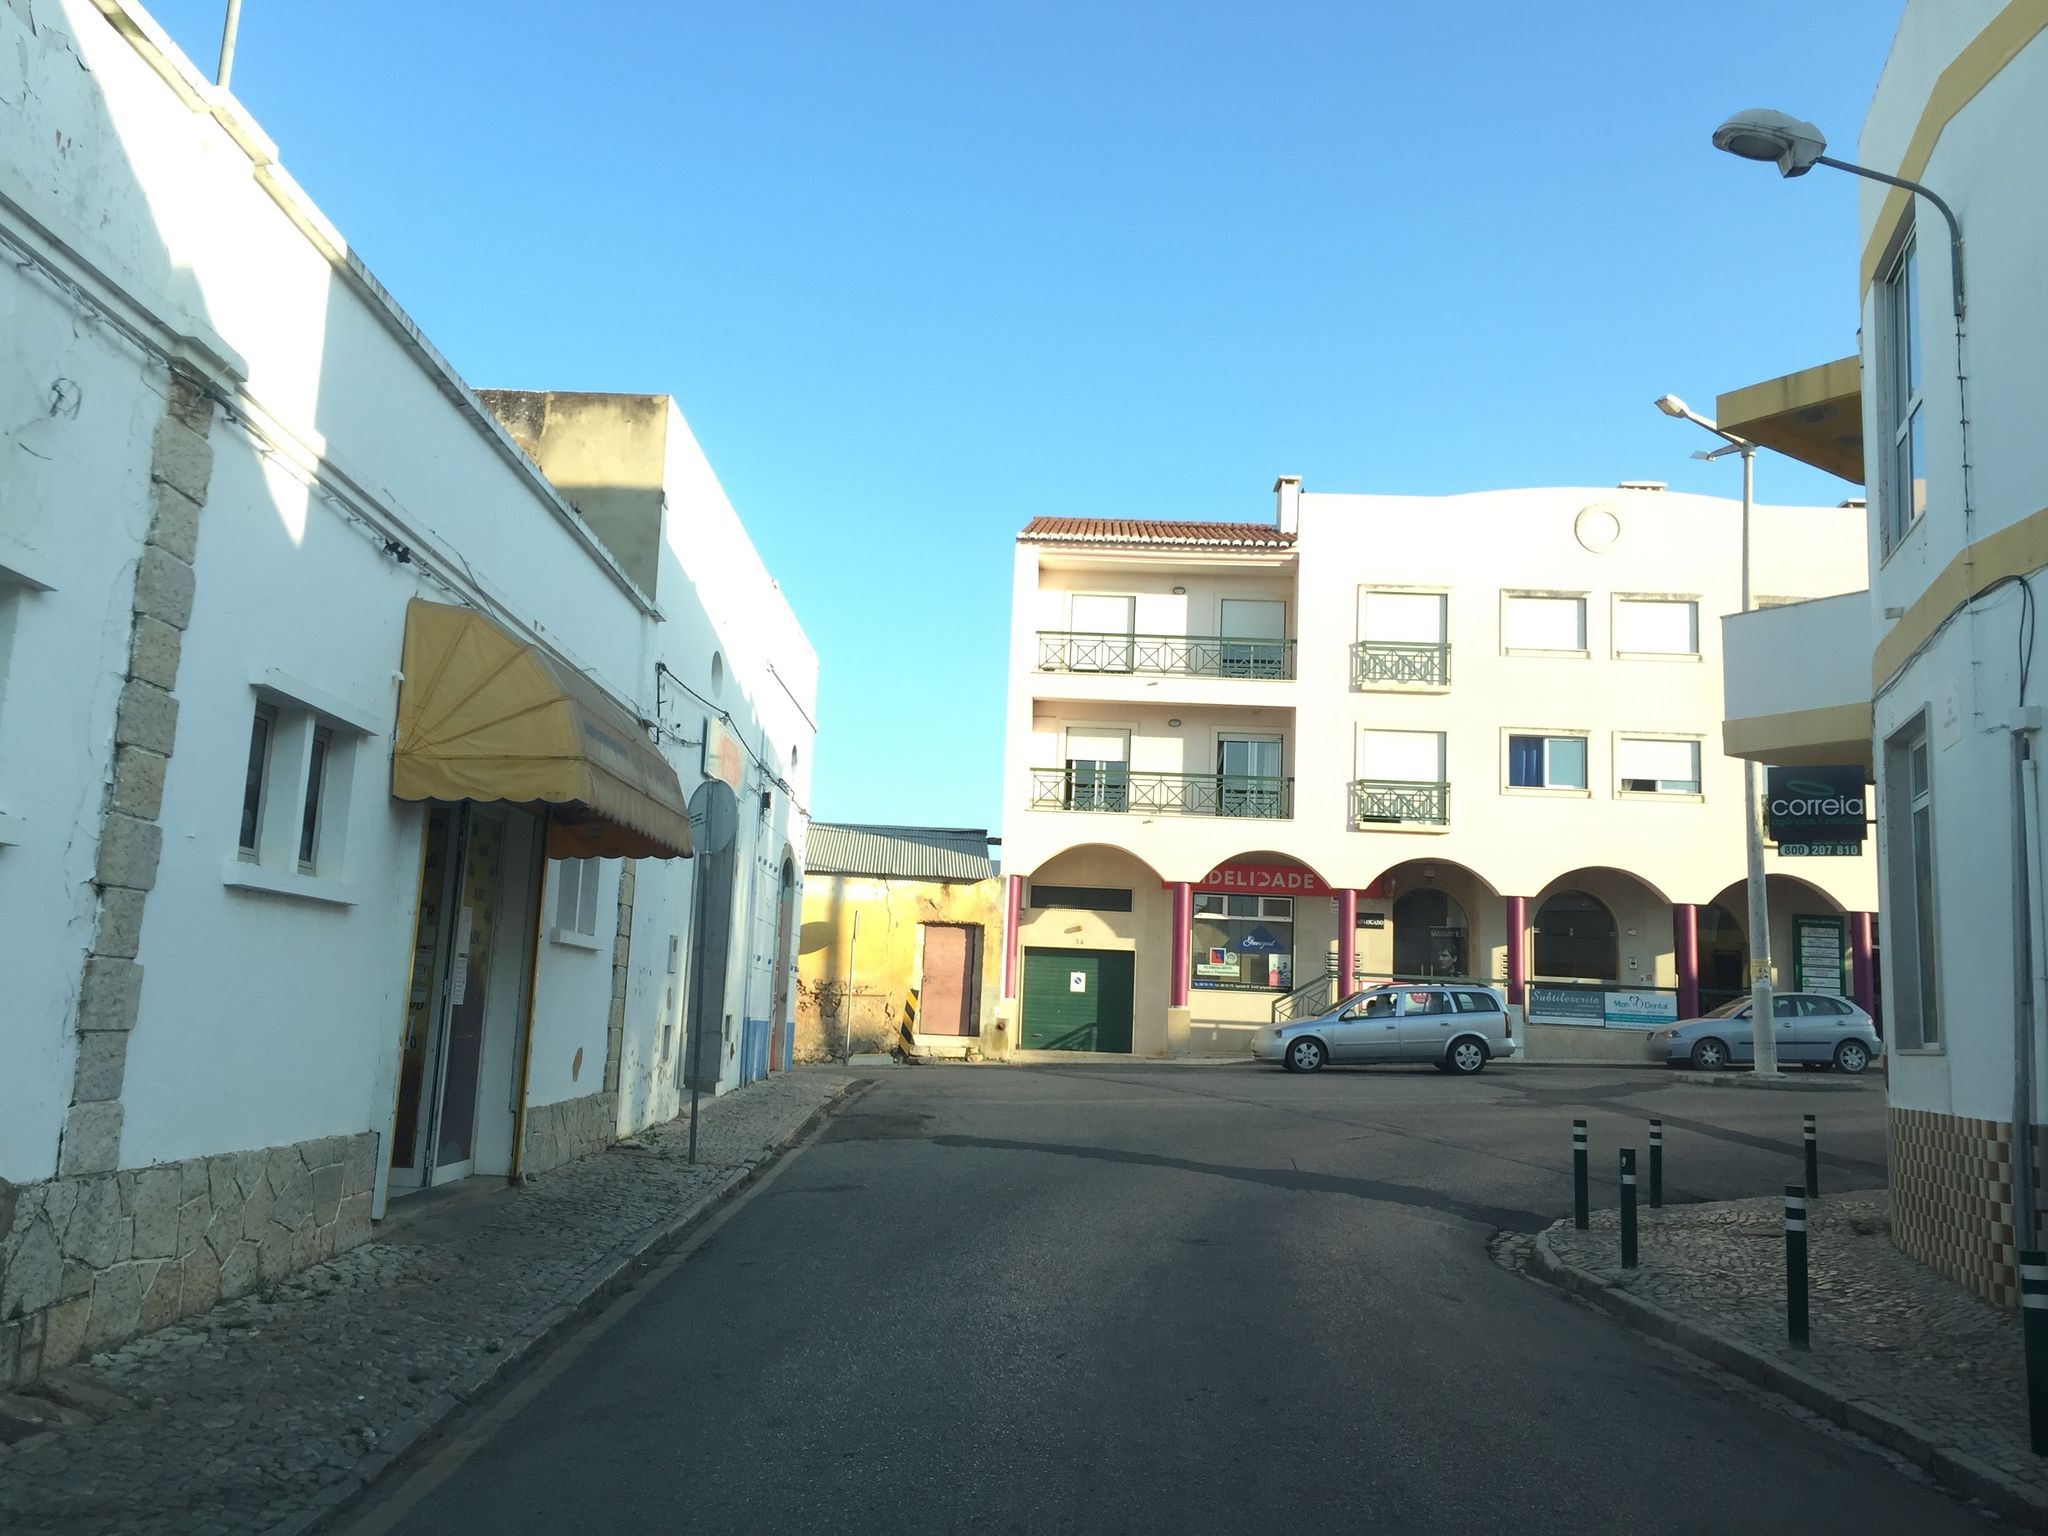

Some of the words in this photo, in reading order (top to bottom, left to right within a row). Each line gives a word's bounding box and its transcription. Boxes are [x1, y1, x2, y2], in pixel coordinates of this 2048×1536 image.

[1771, 795, 1864, 816] correia
[1784, 845, 1805, 855] 800
[1812, 845, 1833, 855] 207
[1837, 845, 1858, 855] 810
[1202, 870, 1314, 889] DELIDADE
[1645, 1001, 1668, 1010] Dental
